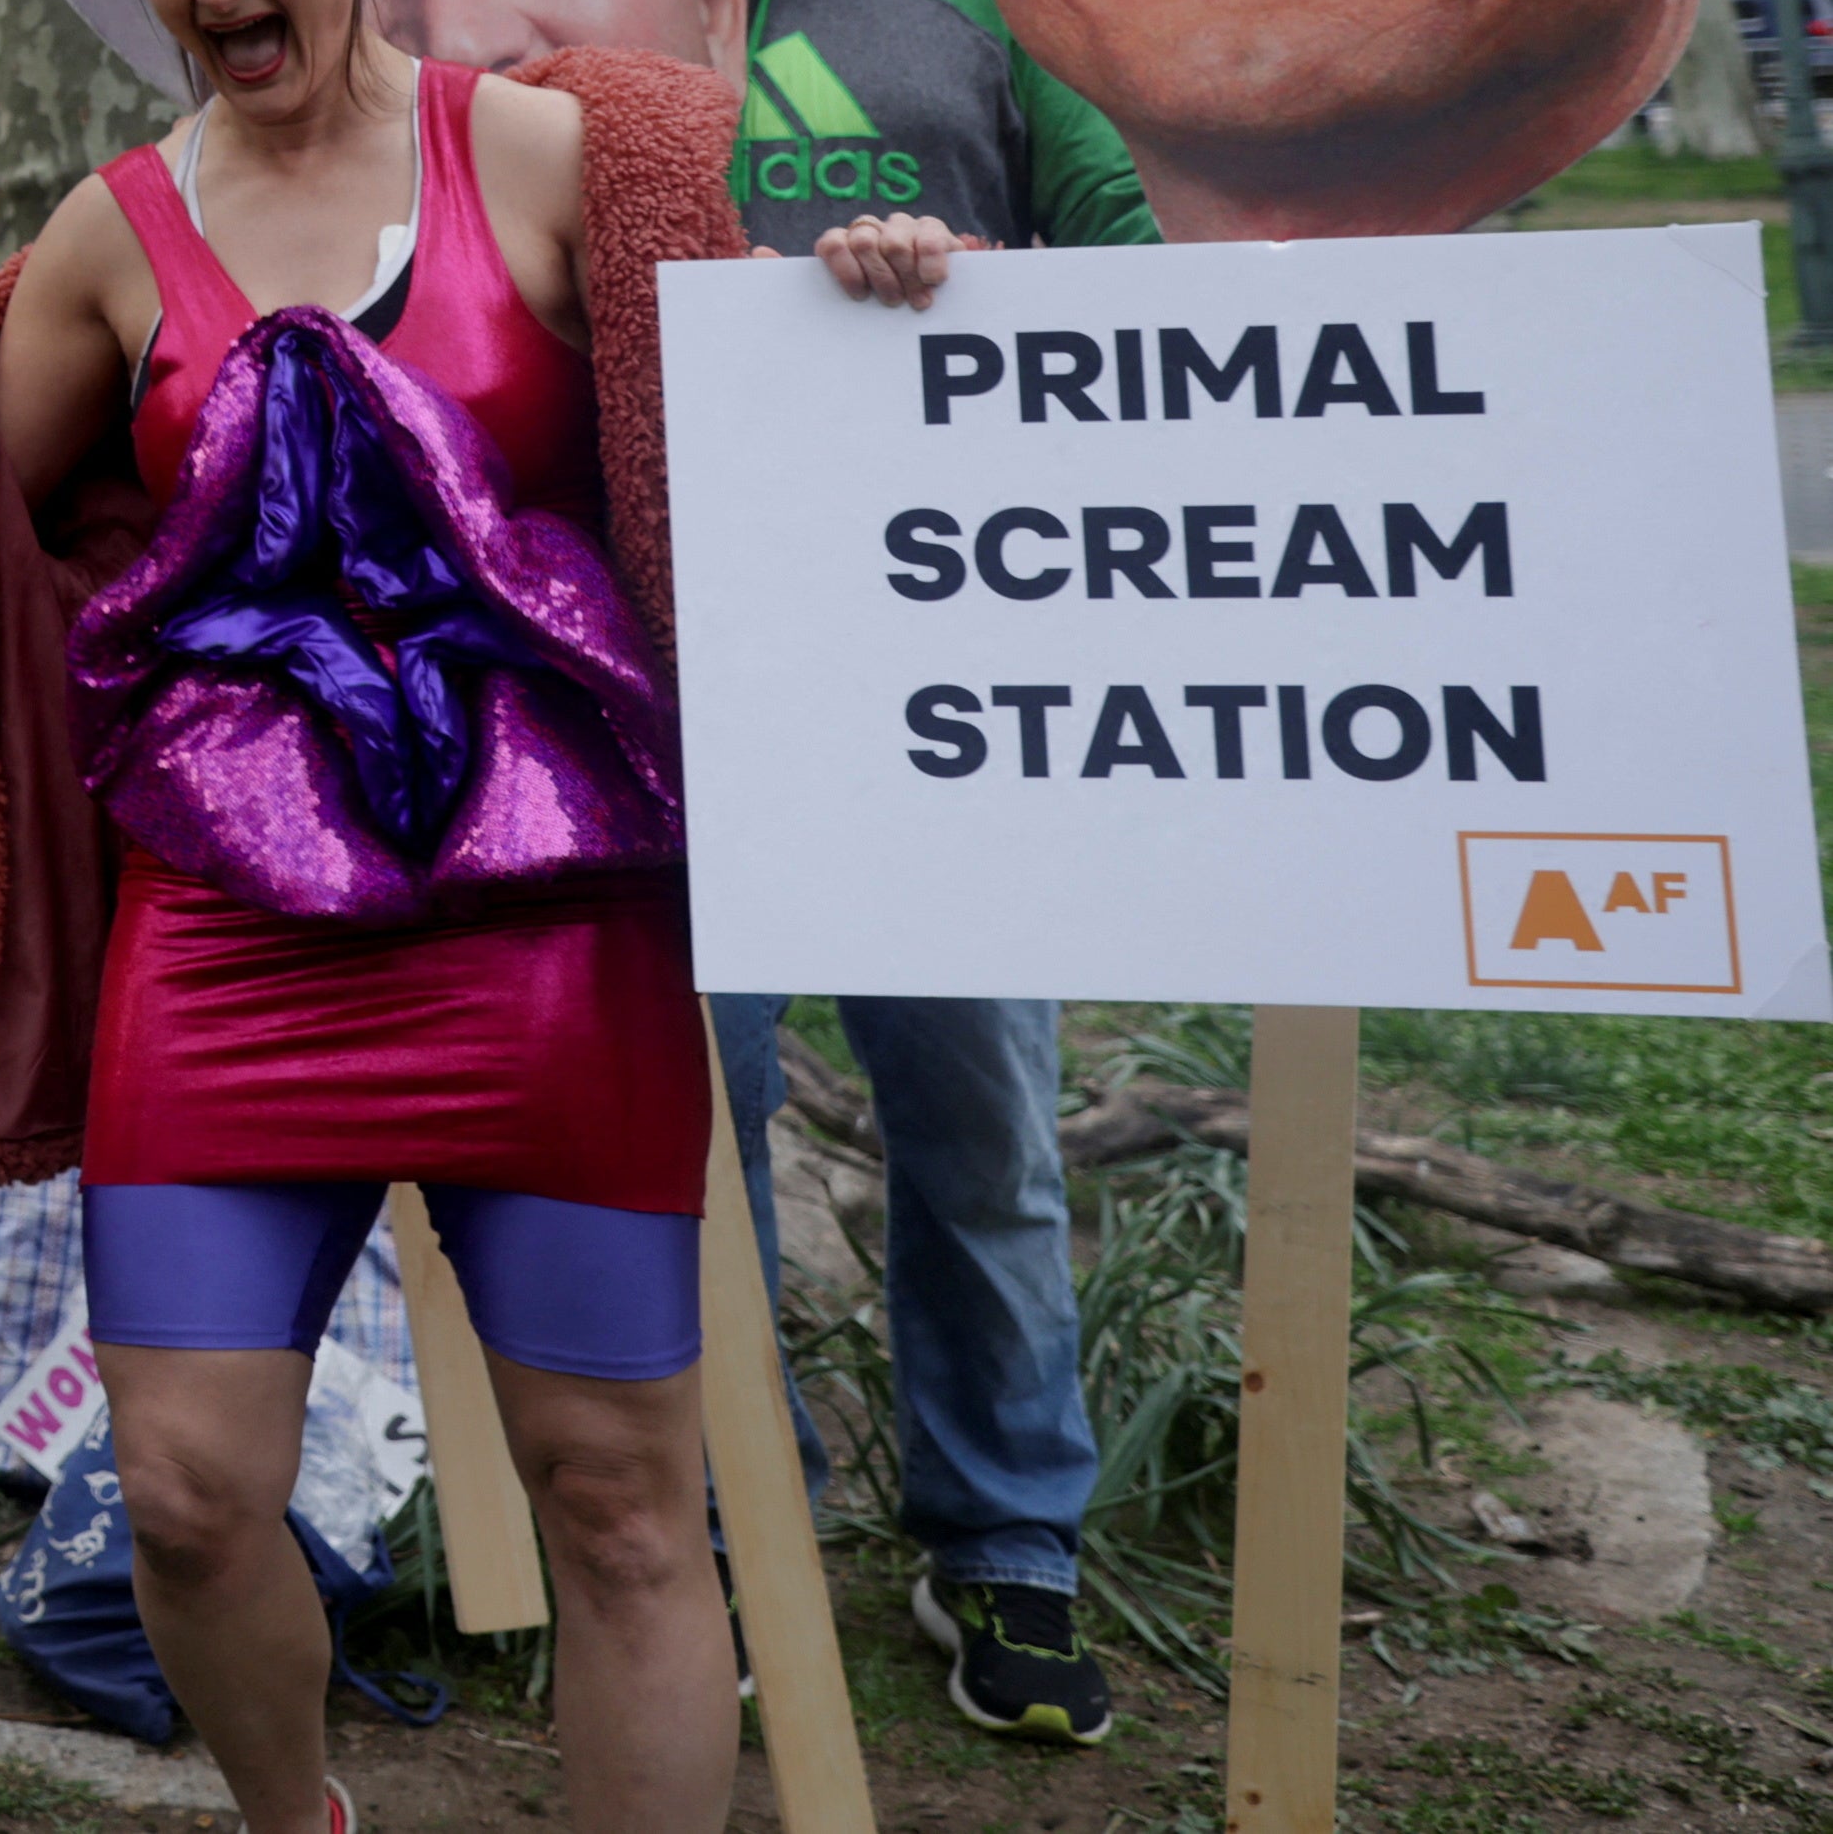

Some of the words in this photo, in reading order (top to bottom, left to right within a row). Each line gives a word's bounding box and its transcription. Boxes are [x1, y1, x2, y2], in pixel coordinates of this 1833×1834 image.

[729, 136, 923, 204] idas
[918, 320, 1486, 425] PRIMAL
[884, 501, 1515, 601] SCREAM
[903, 684, 1548, 783] STATION
